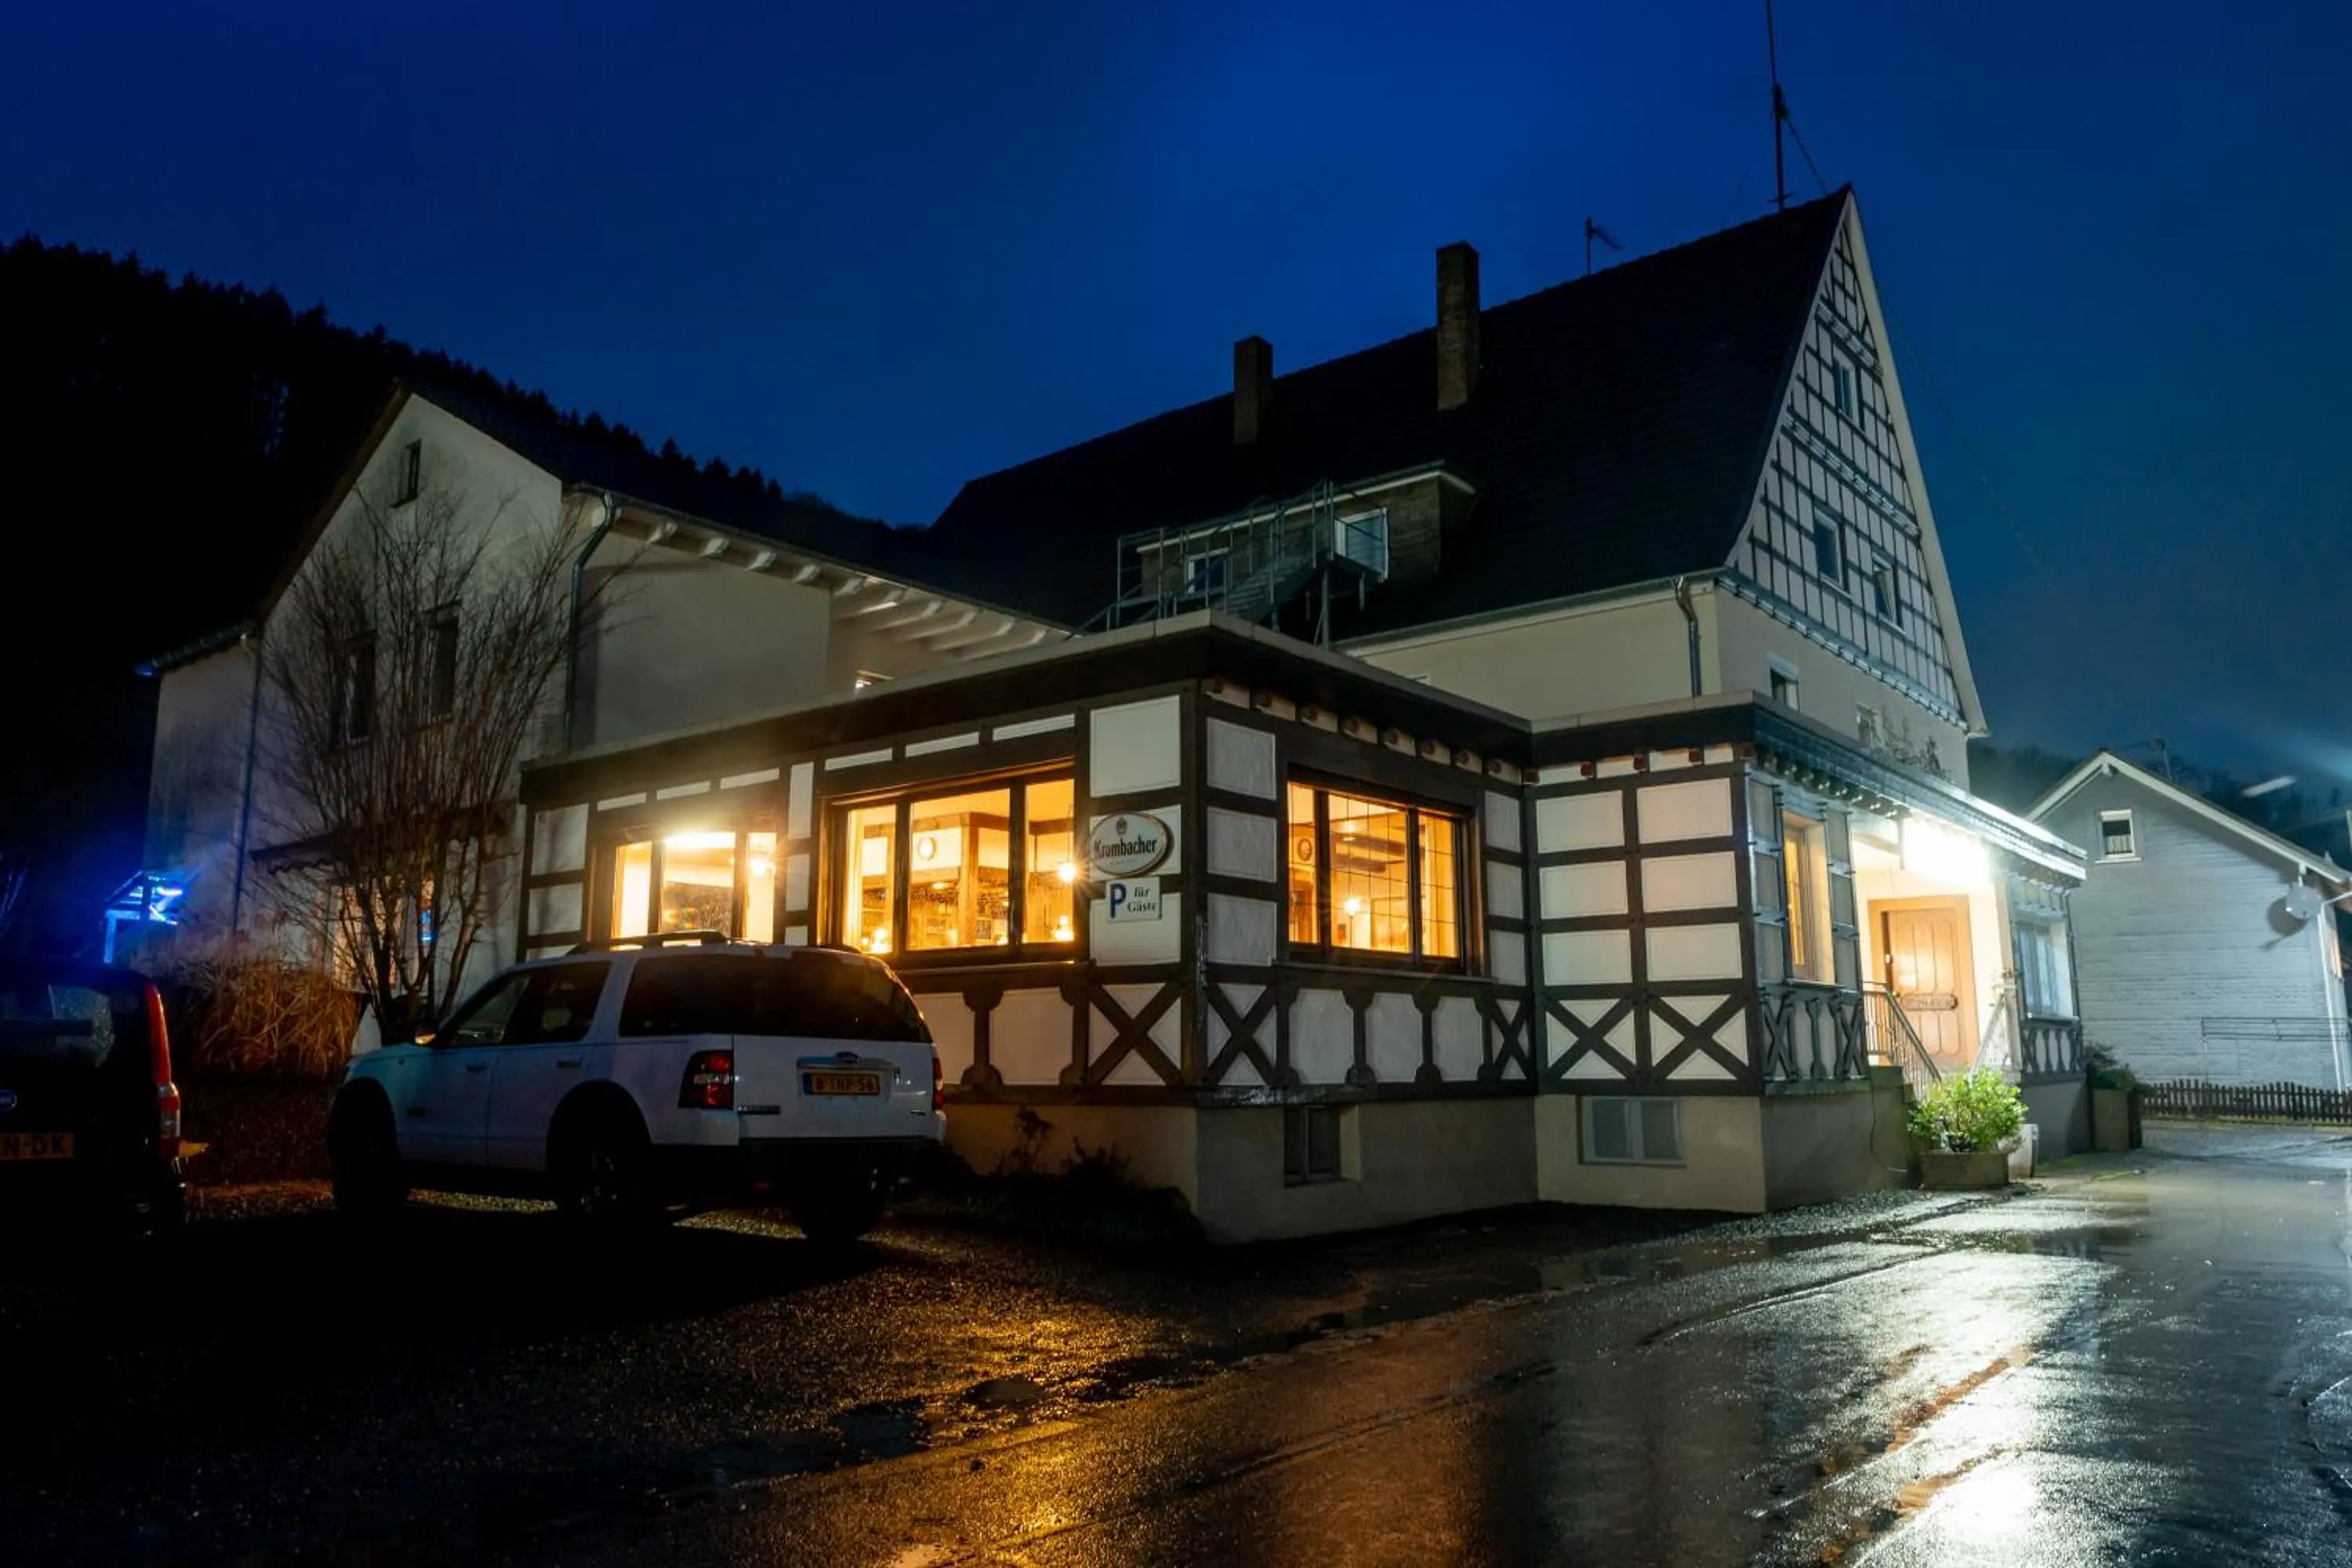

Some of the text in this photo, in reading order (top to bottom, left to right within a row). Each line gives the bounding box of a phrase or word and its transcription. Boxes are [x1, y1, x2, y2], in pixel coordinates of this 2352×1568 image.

[1094, 835, 1158, 859] Krombacher
[1110, 883, 1127, 919] P
[1127, 901, 1156, 913] Gäste
